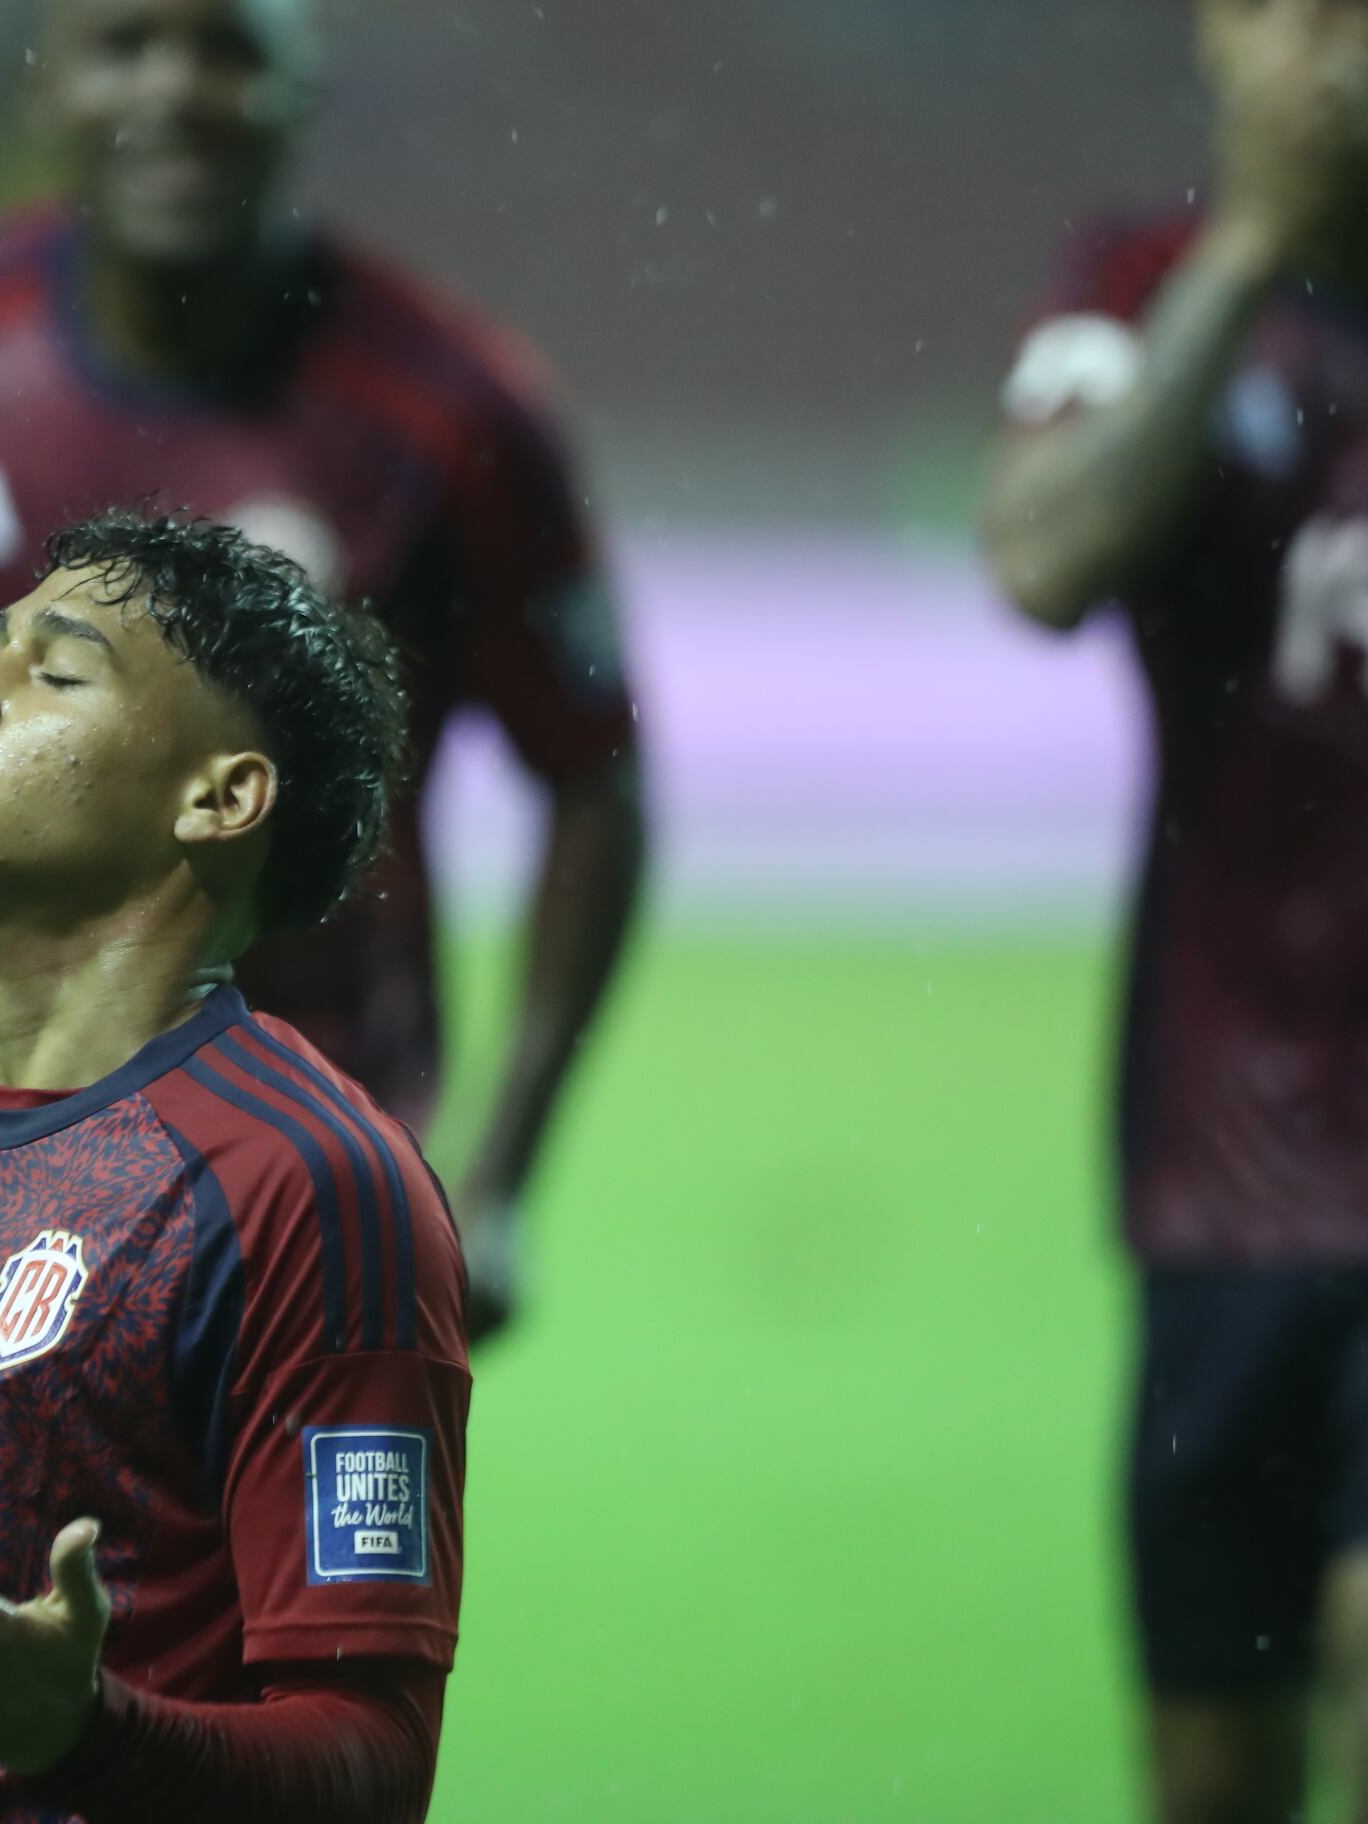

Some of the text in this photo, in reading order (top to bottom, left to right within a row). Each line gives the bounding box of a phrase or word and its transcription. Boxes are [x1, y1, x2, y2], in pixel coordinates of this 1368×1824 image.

[335, 1451, 410, 1473] FOOTBALL
[336, 1473, 411, 1502] UNITES
[331, 1503, 415, 1530] the World
[361, 1536, 393, 1548] FIFA
